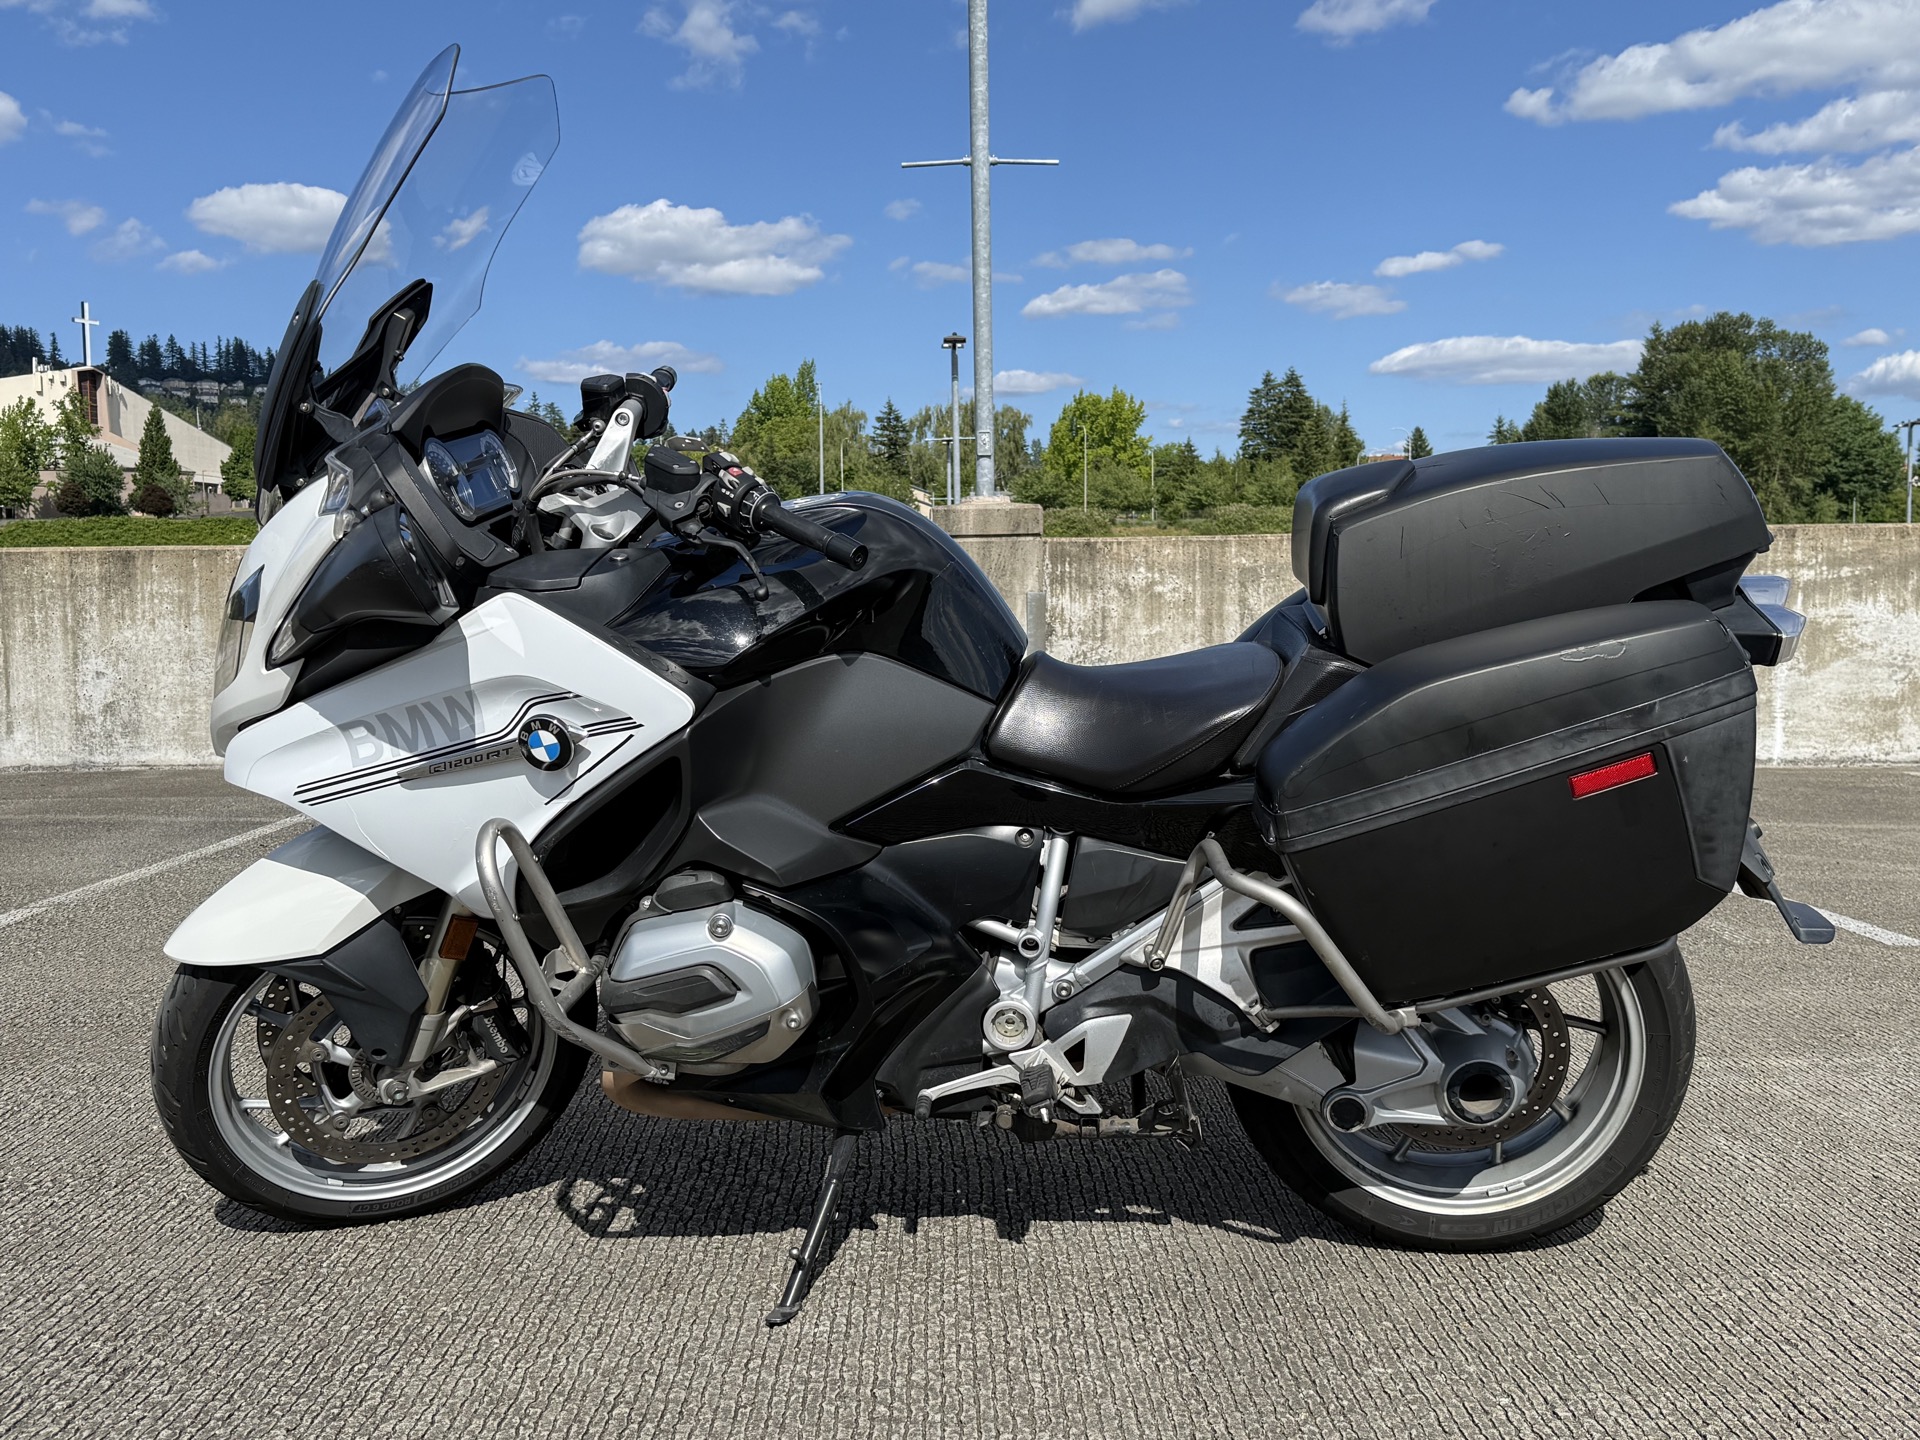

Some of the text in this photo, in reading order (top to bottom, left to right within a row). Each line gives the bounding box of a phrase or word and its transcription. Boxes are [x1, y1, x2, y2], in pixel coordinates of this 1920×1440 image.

[337, 689, 486, 769] BMW
[520, 720, 560, 742] BMW
[483, 1015, 509, 1054] brembo
[421, 1171, 473, 1201] MICHELIN
[372, 1203, 380, 1211] 6
[382, 1197, 411, 1210] ROAD
